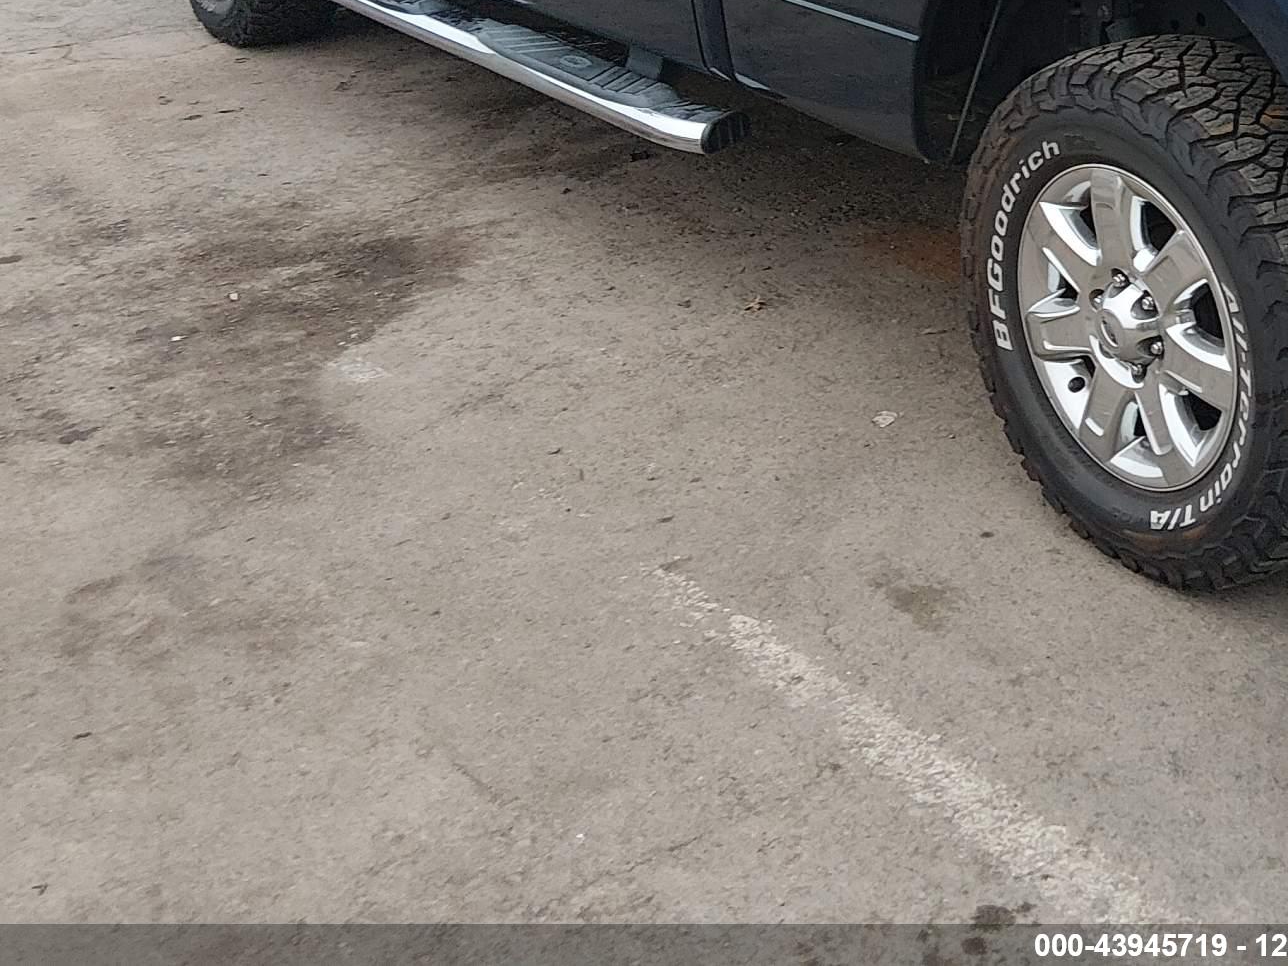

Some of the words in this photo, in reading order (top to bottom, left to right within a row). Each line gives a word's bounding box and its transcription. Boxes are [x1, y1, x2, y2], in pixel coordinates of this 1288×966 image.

[987, 141, 1060, 351] BFGoodrich
[1200, 282, 1251, 512] All-Terrain
[1150, 504, 1196, 530] T/A
